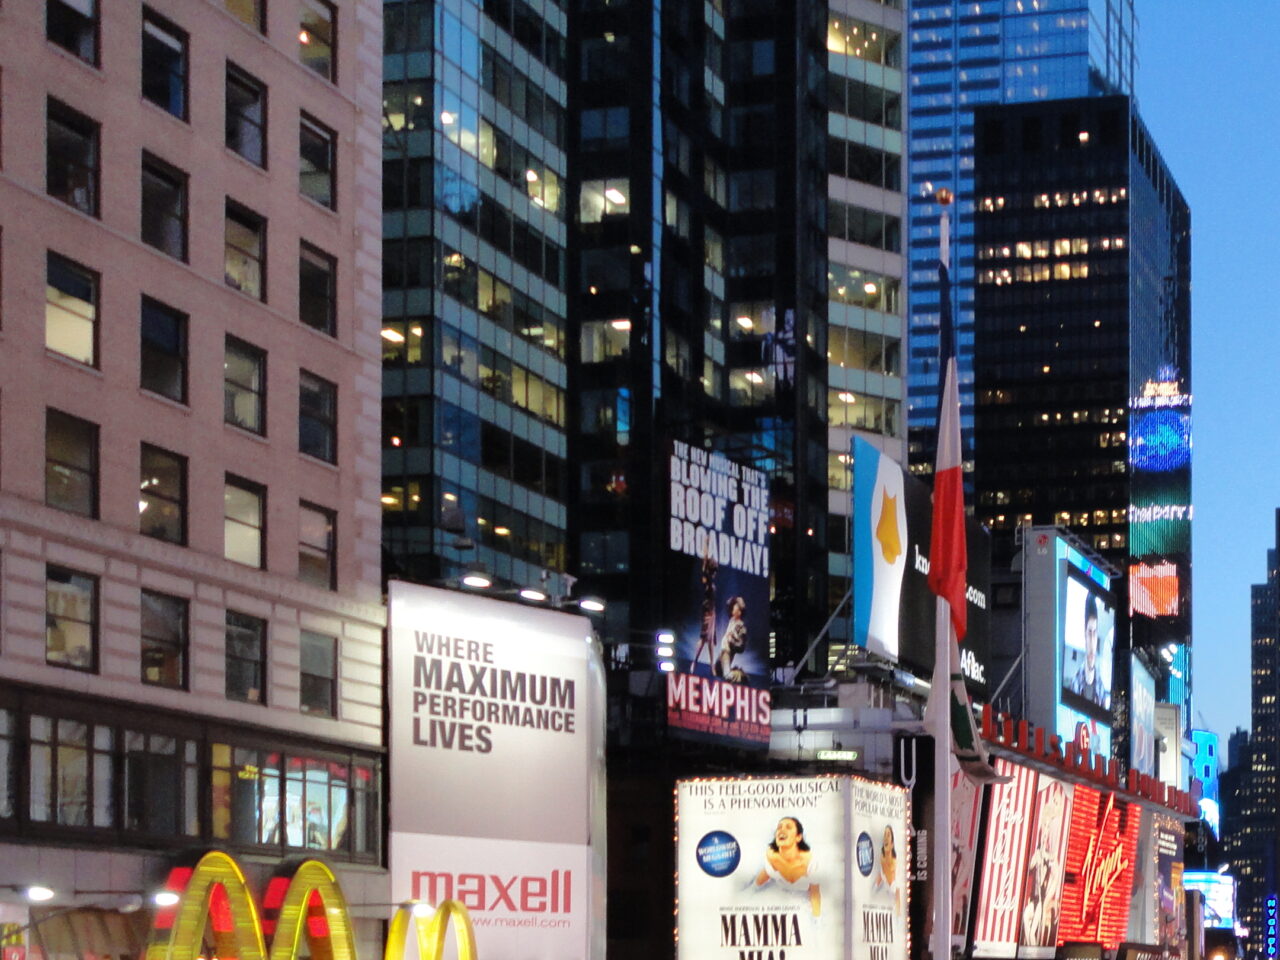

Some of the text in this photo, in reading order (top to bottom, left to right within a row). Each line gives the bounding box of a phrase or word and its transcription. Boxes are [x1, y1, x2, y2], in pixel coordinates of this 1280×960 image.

[673, 440, 689, 461] THE
[670, 455, 769, 513] BLOWING THE
[670, 481, 769, 545] ROOF OFF
[670, 517, 769, 578] BROADWAY!
[414, 630, 494, 664] WHERE
[413, 655, 576, 710] MAXIMUM
[667, 672, 772, 726] MEMPHIS
[413, 691, 576, 734] PERFORMANCE
[412, 716, 493, 753] LIVES
[703, 798, 714, 810] IS
[718, 798, 727, 810] A
[788, 780, 842, 794] MUSICAL
[1082, 791, 1130, 941] Virgin
[411, 869, 572, 913] maxell
[720, 913, 802, 947] MAMMA
[862, 910, 894, 943] MAMMA
